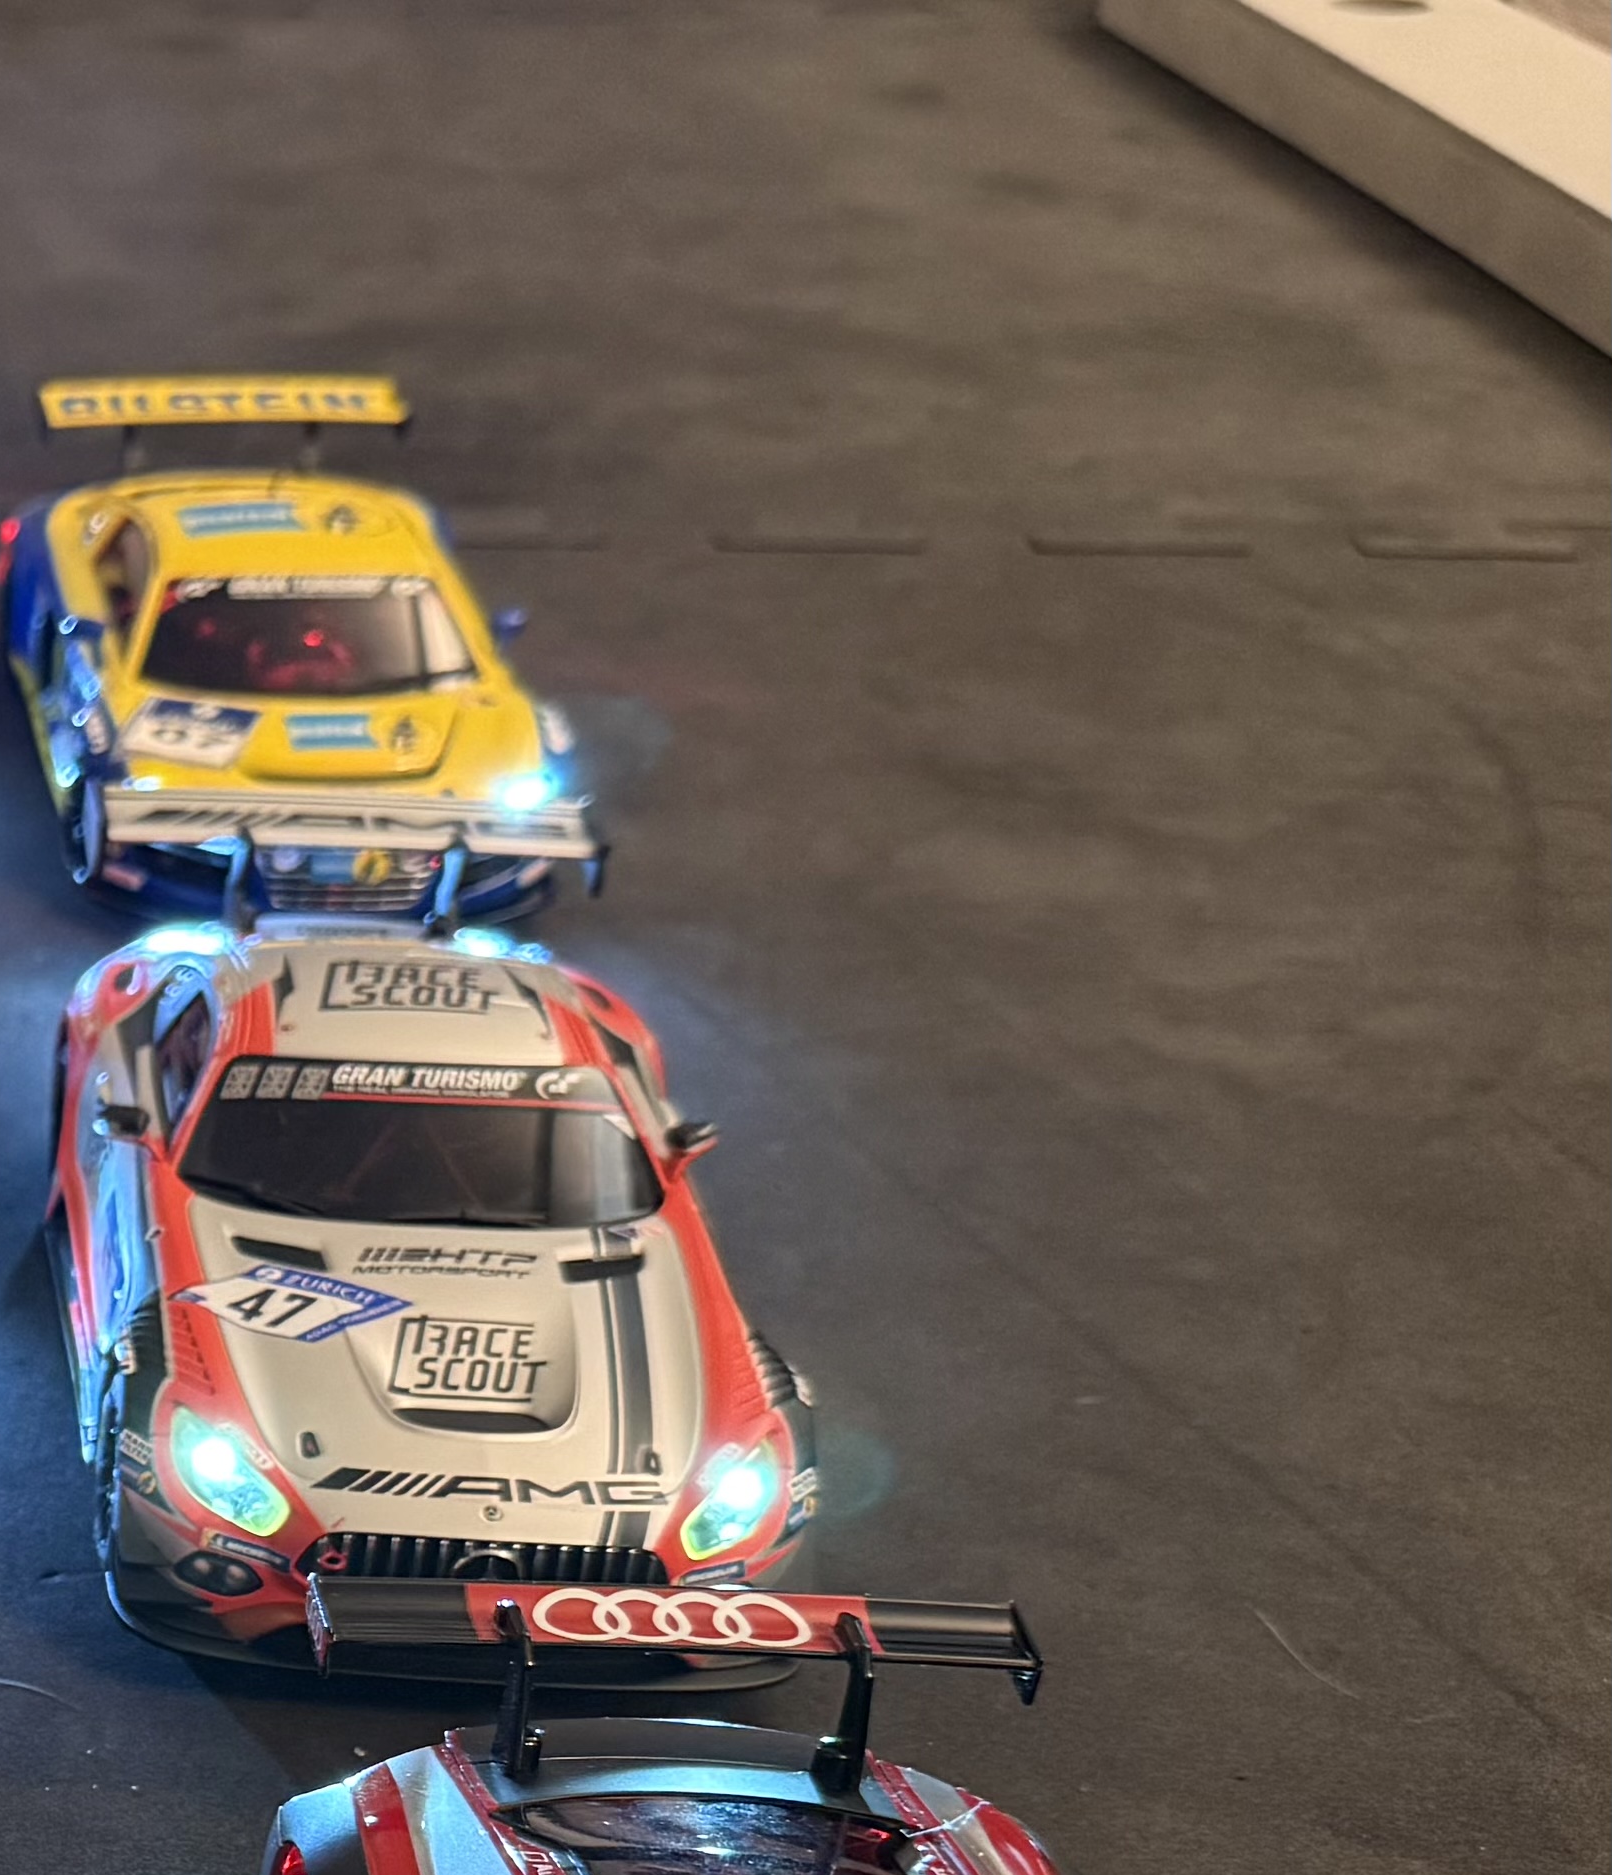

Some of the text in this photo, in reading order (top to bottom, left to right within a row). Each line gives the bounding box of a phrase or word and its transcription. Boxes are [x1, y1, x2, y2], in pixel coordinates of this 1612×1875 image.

[350, 984, 501, 1012] SCOUT
[332, 1063, 519, 1093] GRAN TURISMO
[226, 1287, 318, 1329] 47
[413, 1357, 548, 1395] SCOUT
[426, 1474, 669, 1507] AMG
